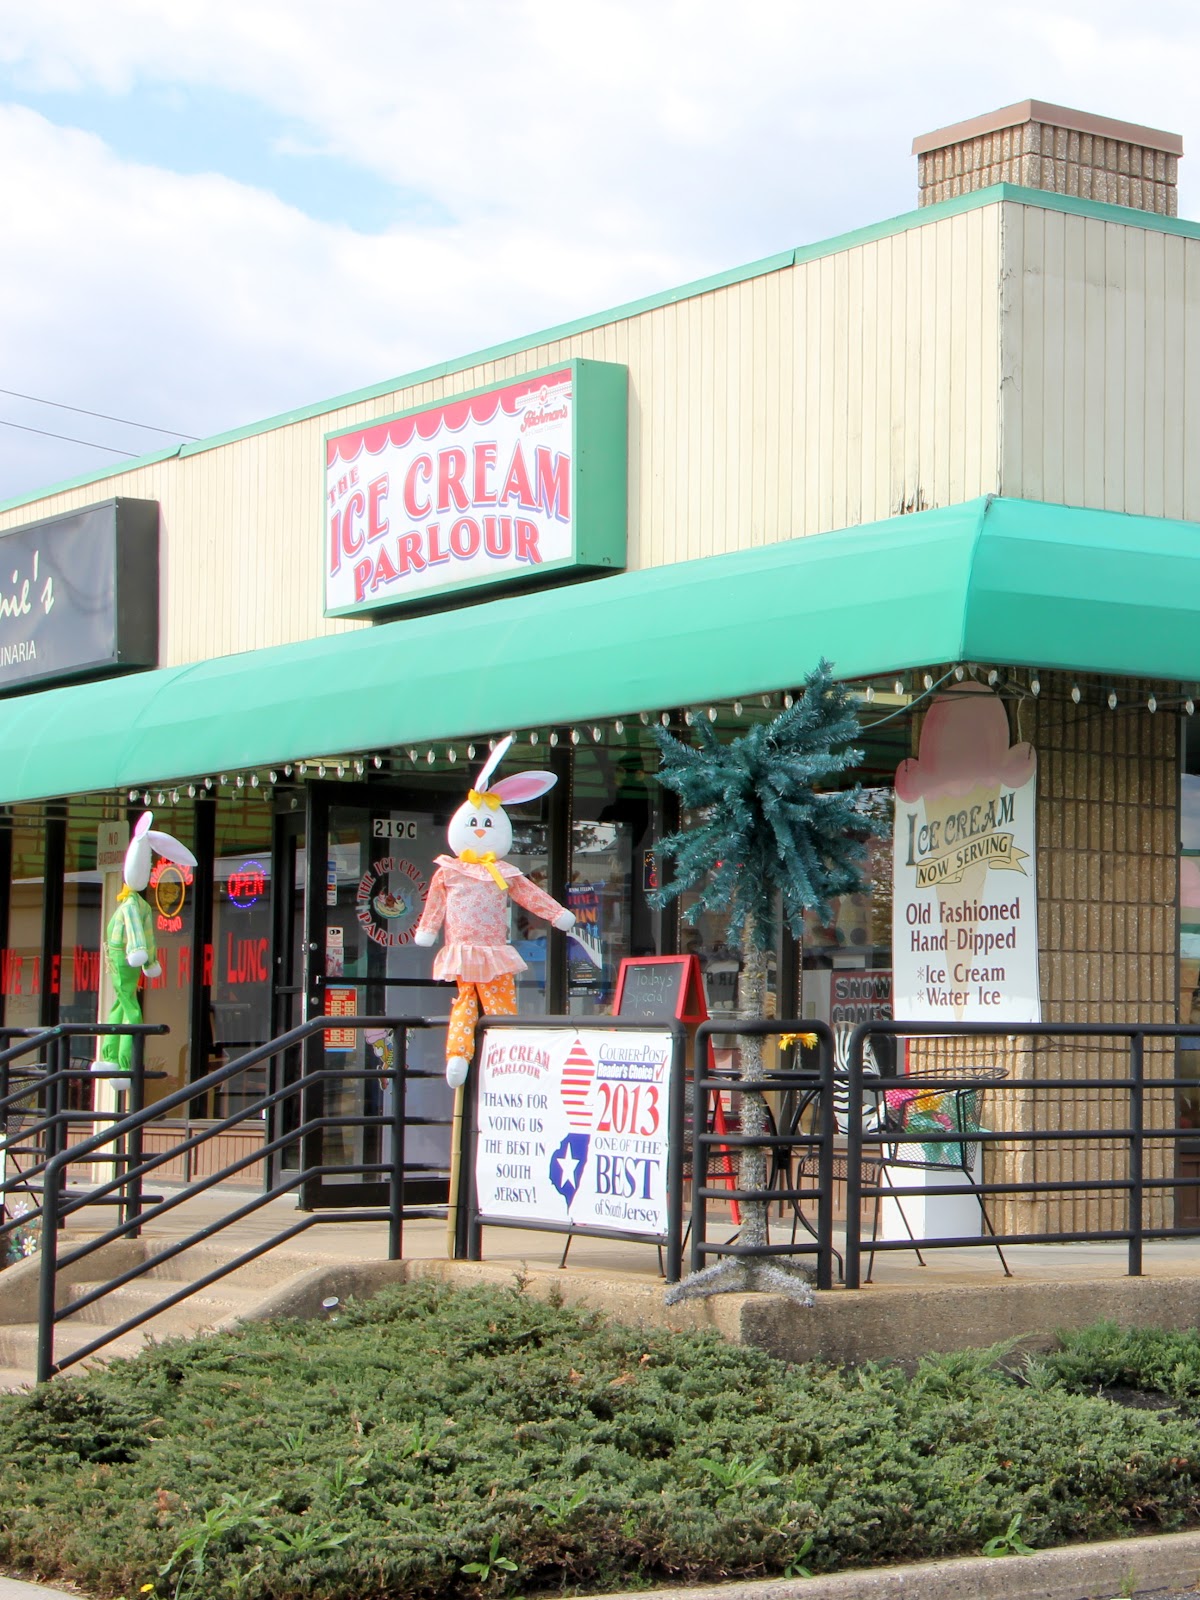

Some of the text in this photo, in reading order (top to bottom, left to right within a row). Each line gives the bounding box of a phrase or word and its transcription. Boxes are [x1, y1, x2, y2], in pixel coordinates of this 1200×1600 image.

[520, 404, 568, 433] Richman's
[327, 465, 358, 506] THE
[330, 438, 571, 578] ICE CREAM
[353, 515, 543, 603] PARLOUR
[0, 640, 37, 667] INARIA
[108, 832, 119, 846] NO
[375, 821, 416, 838] 219C
[905, 792, 1016, 866] ICE CREAM
[918, 835, 1008, 886] NOW SERVING
[227, 870, 266, 898] OPEN
[358, 871, 376, 902] THE
[374, 857, 396, 876] ICE
[906, 897, 1021, 924] Old Fashioned
[357, 912, 422, 947] PARLOU
[911, 927, 1017, 955] Hand-Dipped
[1, 949, 22, 994] WE
[32, 954, 60, 994] AE
[72, 944, 100, 992] NOW
[637, 968, 673, 993] Today's
[925, 963, 1006, 983] Ice Cream
[624, 988, 667, 1009] Special
[835, 976, 892, 999] SNOW
[926, 986, 1001, 1006] Water Ice
[487, 1043, 550, 1071] ICE CREAM
[492, 1063, 540, 1080] PARLOUR
[598, 1063, 653, 1080] Reader's Choice
[484, 1092, 548, 1109] THANKS FOR
[596, 1082, 660, 1136] 2013
[488, 1115, 543, 1133] VOTING US
[485, 1139, 545, 1156] THE BEST IN
[595, 1137, 662, 1155] ONE OF THE
[496, 1163, 531, 1179] SOUTH
[595, 1154, 660, 1200] BEST
[494, 1186, 537, 1204] JERSEY!
[595, 1198, 660, 1227] of South Jersey
